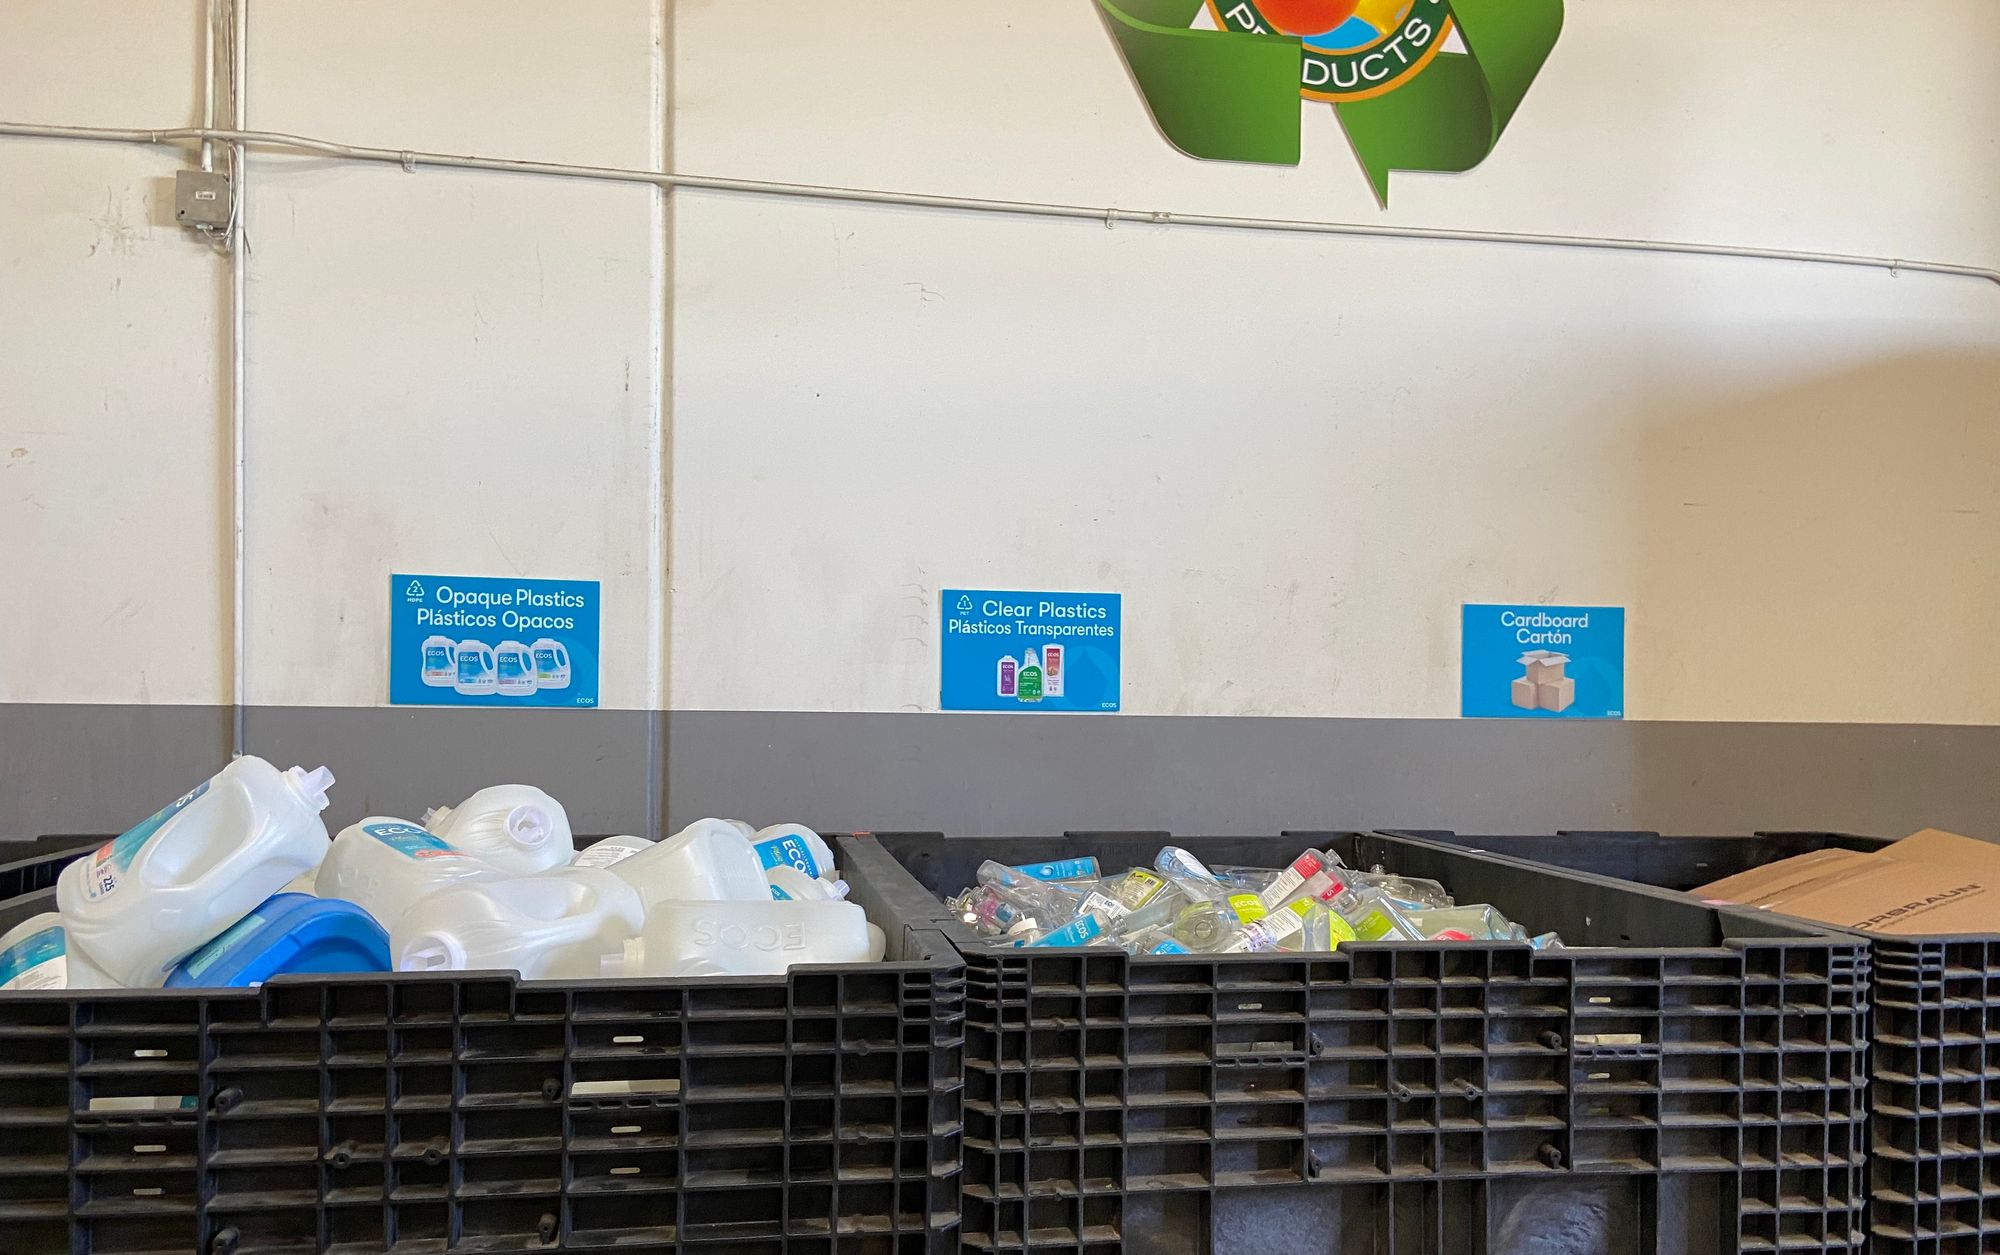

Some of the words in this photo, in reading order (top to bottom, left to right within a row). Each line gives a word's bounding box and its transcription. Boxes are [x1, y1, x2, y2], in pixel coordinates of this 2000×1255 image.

[1225, 2, 1431, 87] PDUCTS
[436, 586, 512, 609] Opaque
[516, 588, 585, 608] Plastics
[417, 607, 497, 627] Plásticos
[502, 610, 574, 632] Opacos
[982, 600, 1033, 617] Clear
[1039, 601, 1107, 619] Plastics
[1501, 610, 1589, 629] Cardboard
[949, 619, 1012, 635] Plásticos
[1016, 620, 1114, 639] Transparentes
[1516, 628, 1572, 645] Cartón
[374, 827, 421, 836] ECO
[782, 839, 807, 874] ECO
[103, 875, 114, 892] 225
[691, 919, 807, 951] ECOS
[1075, 919, 1089, 939] ECOS
